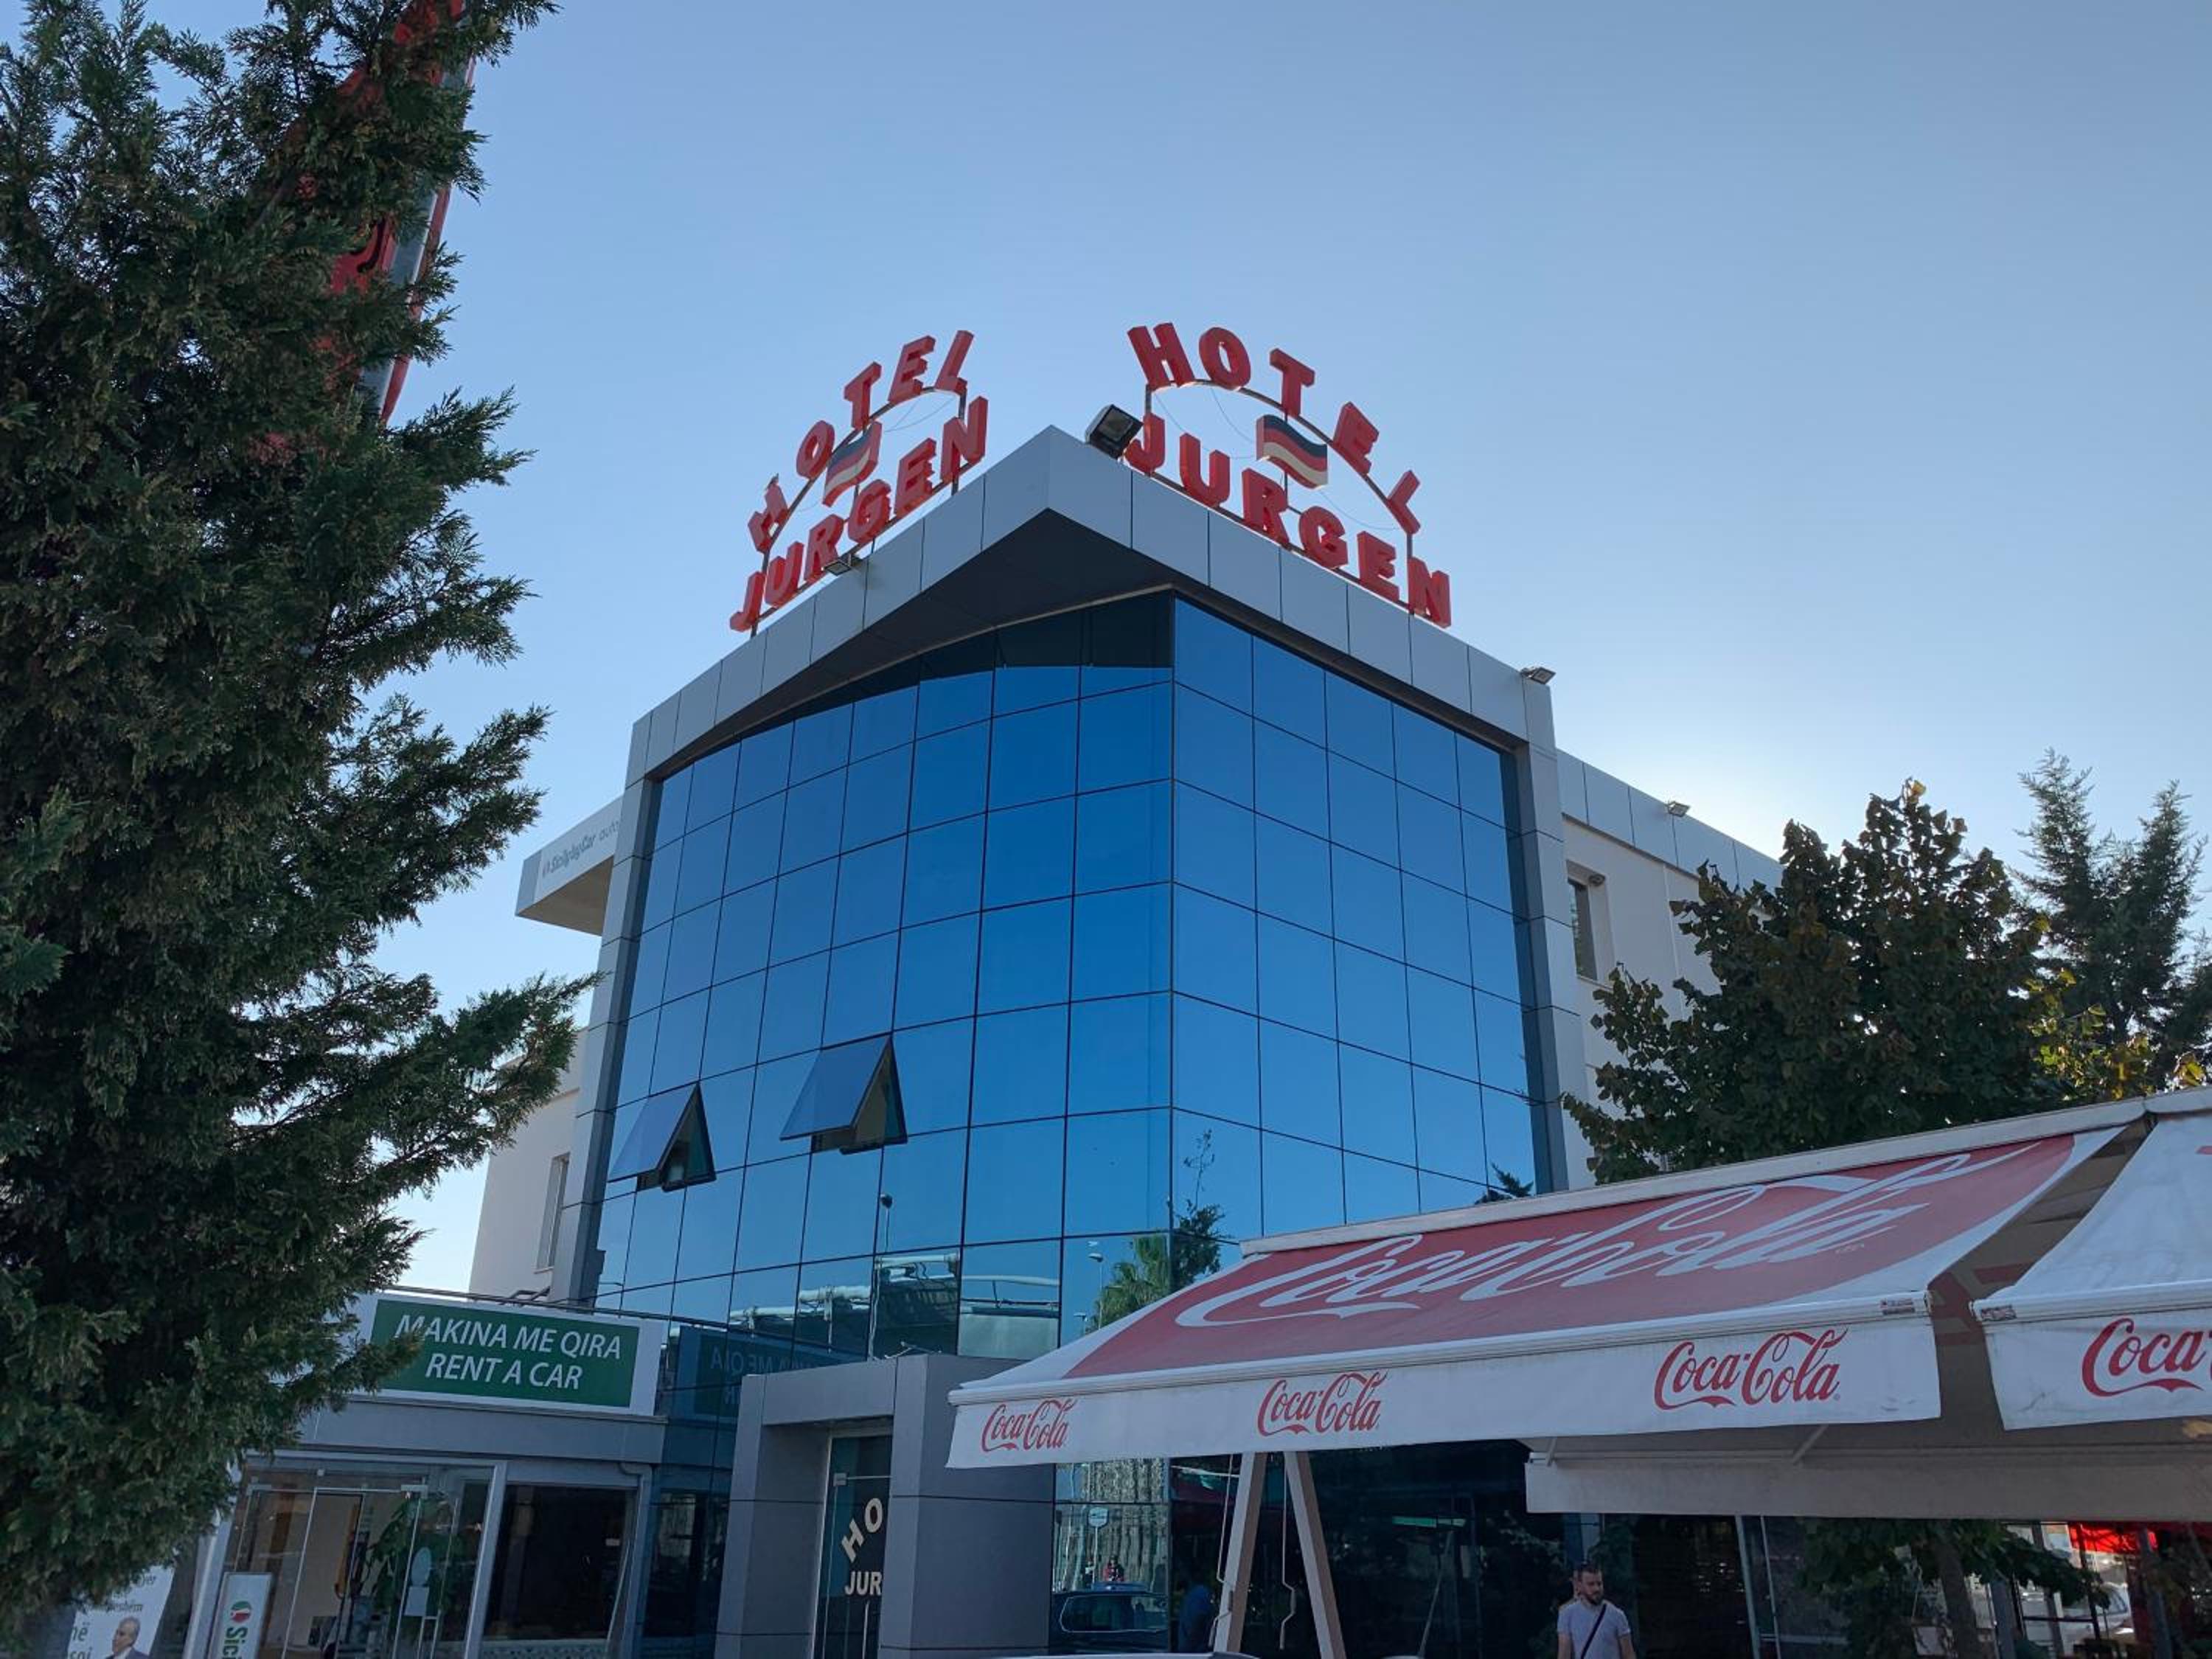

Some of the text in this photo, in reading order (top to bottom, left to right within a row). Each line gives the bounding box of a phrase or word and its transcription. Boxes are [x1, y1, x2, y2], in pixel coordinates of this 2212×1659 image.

[748, 330, 974, 554] HOTEL
[1127, 322, 1421, 535] HOTEL
[729, 396, 989, 632] JURGEN
[1122, 412, 1452, 629] JURGEN
[393, 1314, 621, 1360] MAKINA ME QIRA
[425, 1352, 583, 1390] RENT A CAR
[1654, 1326, 1849, 1411] Coca-Cola
[2081, 1317, 2212, 1397] Coca
[981, 1399, 1078, 1453] Coca-Cola
[1257, 1369, 1391, 1437] Coca-Cola
[844, 1571, 883, 1596] JUR
